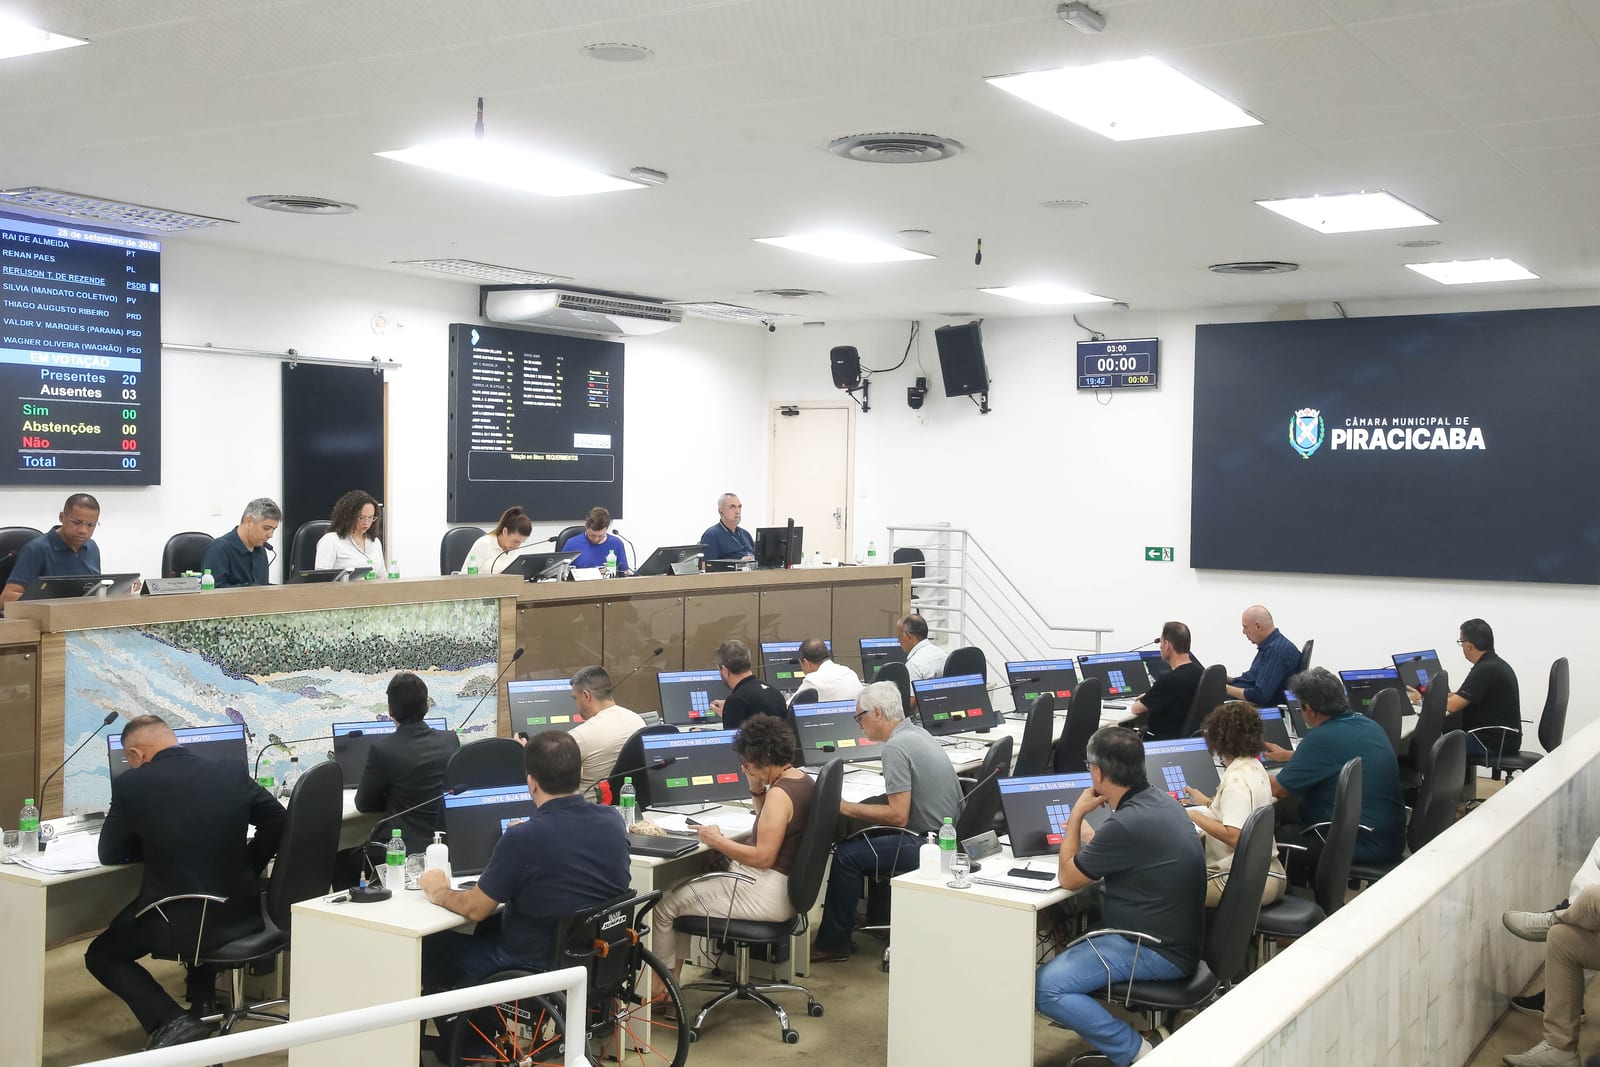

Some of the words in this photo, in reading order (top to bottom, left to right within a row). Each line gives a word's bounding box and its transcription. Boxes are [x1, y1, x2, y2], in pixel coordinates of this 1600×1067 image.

[18, 235, 30, 243] DE
[32, 237, 69, 248] ALMEIDA
[71, 230, 81, 239] de
[83, 233, 123, 245] setembro
[126, 239, 136, 247] de
[2, 249, 31, 259] RENAN
[33, 253, 56, 262] PAES
[2, 266, 44, 277] RERLISON
[55, 272, 66, 280] DE
[69, 275, 106, 286] REZENDE
[2, 283, 29, 292] SILVIA
[31, 286, 74, 298] (MANDATO
[76, 291, 118, 303] COLETIVO)
[126, 281, 147, 290] PSDB
[4, 300, 35, 310] THIAGO
[37, 304, 77, 314] AUGUSTO
[78, 307, 110, 317] RIBEIRO
[3, 318, 34, 327] VALDIR
[45, 322, 85, 332] MARQUES
[3, 336, 41, 346] WAGNER
[42, 340, 80, 350] OLIVEIRA
[81, 343, 122, 354] (WAGNÃO)
[126, 346, 142, 354] PSD
[30, 352, 49, 363] EM
[52, 354, 110, 368] VOTAÇÃO
[1097, 357, 1136, 371] 00:00
[40, 368, 106, 384] Presentes
[122, 374, 137, 385] 20
[40, 384, 102, 398] Ausentes
[122, 389, 137, 400] 03
[22, 404, 49, 416] Sim
[122, 409, 137, 420] 00
[22, 421, 101, 435] Abstenções
[122, 424, 137, 435] 00
[1345, 416, 1388, 426] CÂMARA
[1392, 417, 1451, 426] MUNICIPAL
[1455, 416, 1470, 425] DE
[22, 436, 50, 448] Não
[122, 440, 137, 450] 00
[1331, 427, 1486, 450] PIRACICABA
[22, 455, 57, 467] Total
[122, 457, 137, 468] 00
